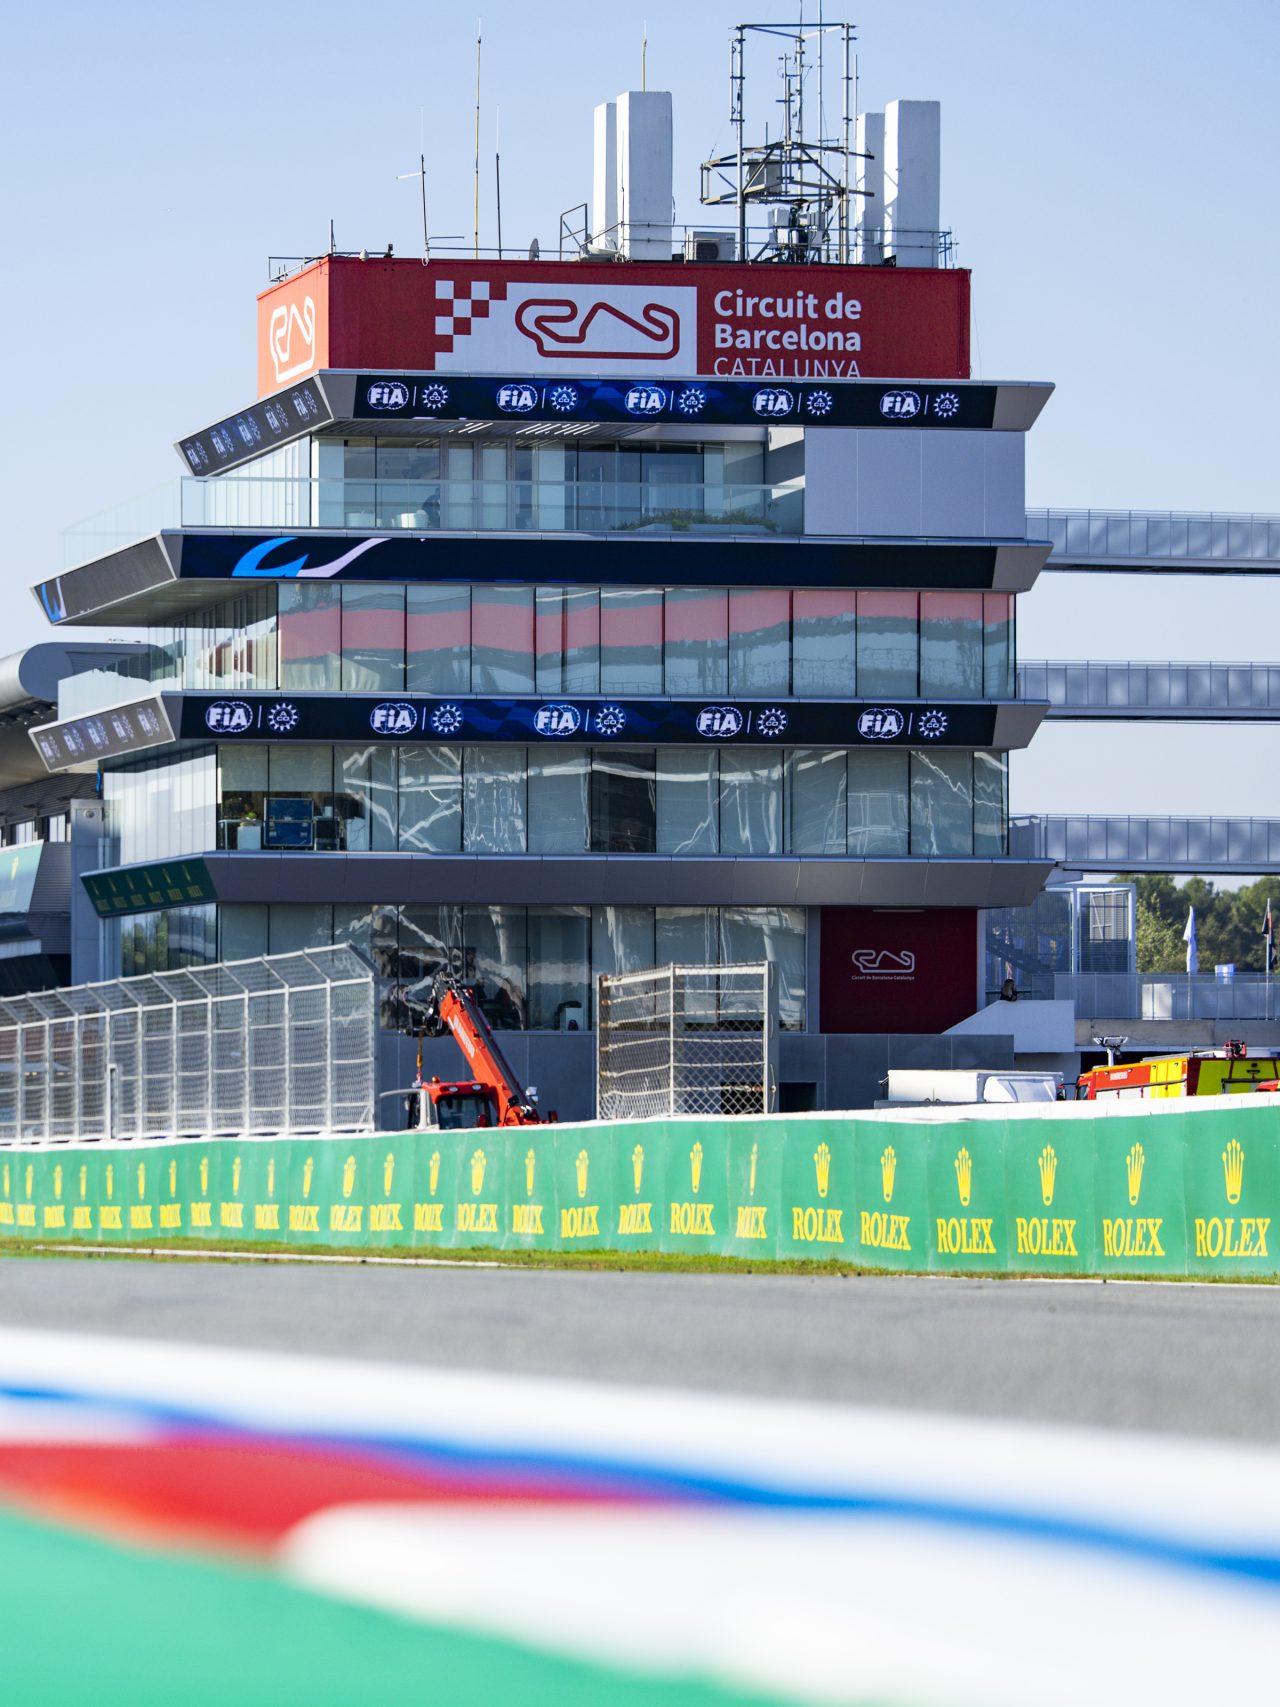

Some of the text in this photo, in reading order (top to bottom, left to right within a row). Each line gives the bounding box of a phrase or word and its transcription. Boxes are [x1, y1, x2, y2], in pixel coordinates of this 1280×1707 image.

[713, 288, 862, 320] Circuit de
[714, 323, 862, 352] Barcelona
[670, 1203, 715, 1235] ROLEX
[792, 1207, 844, 1243] ROLEX
[860, 1211, 911, 1251] ROLEX
[936, 1218, 996, 1254] ROLEX
[1015, 1217, 1078, 1256] ROLEX
[1194, 1217, 1271, 1257] ROLEX
[1103, 1218, 1165, 1257] ROLEX
